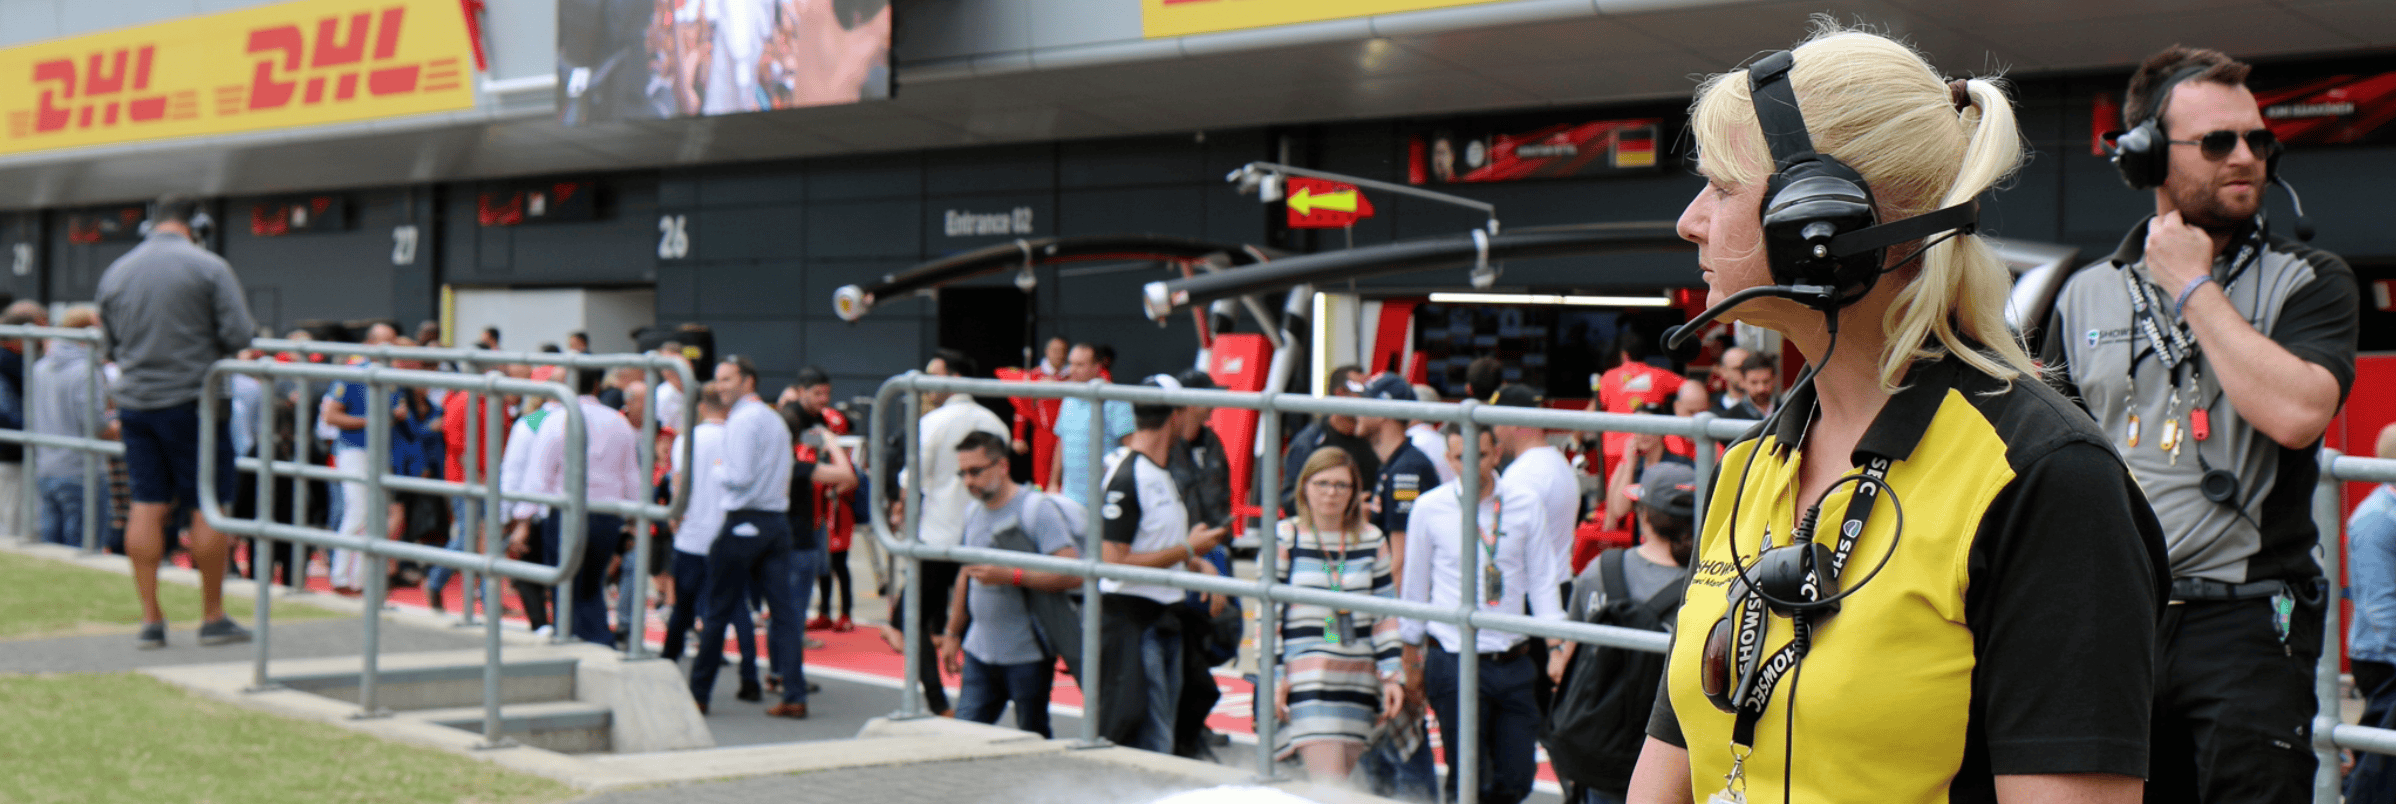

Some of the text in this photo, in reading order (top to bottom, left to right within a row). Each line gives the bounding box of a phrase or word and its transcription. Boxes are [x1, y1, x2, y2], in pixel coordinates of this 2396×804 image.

[246, 7, 420, 111] DHL
[33, 45, 167, 133] DHL
[657, 214, 690, 260] 26
[944, 206, 1033, 237] Entrance 02
[392, 224, 419, 266] 27
[2141, 316, 2172, 361] SHOWSEC
[1744, 644, 1796, 714] HOWSEC
